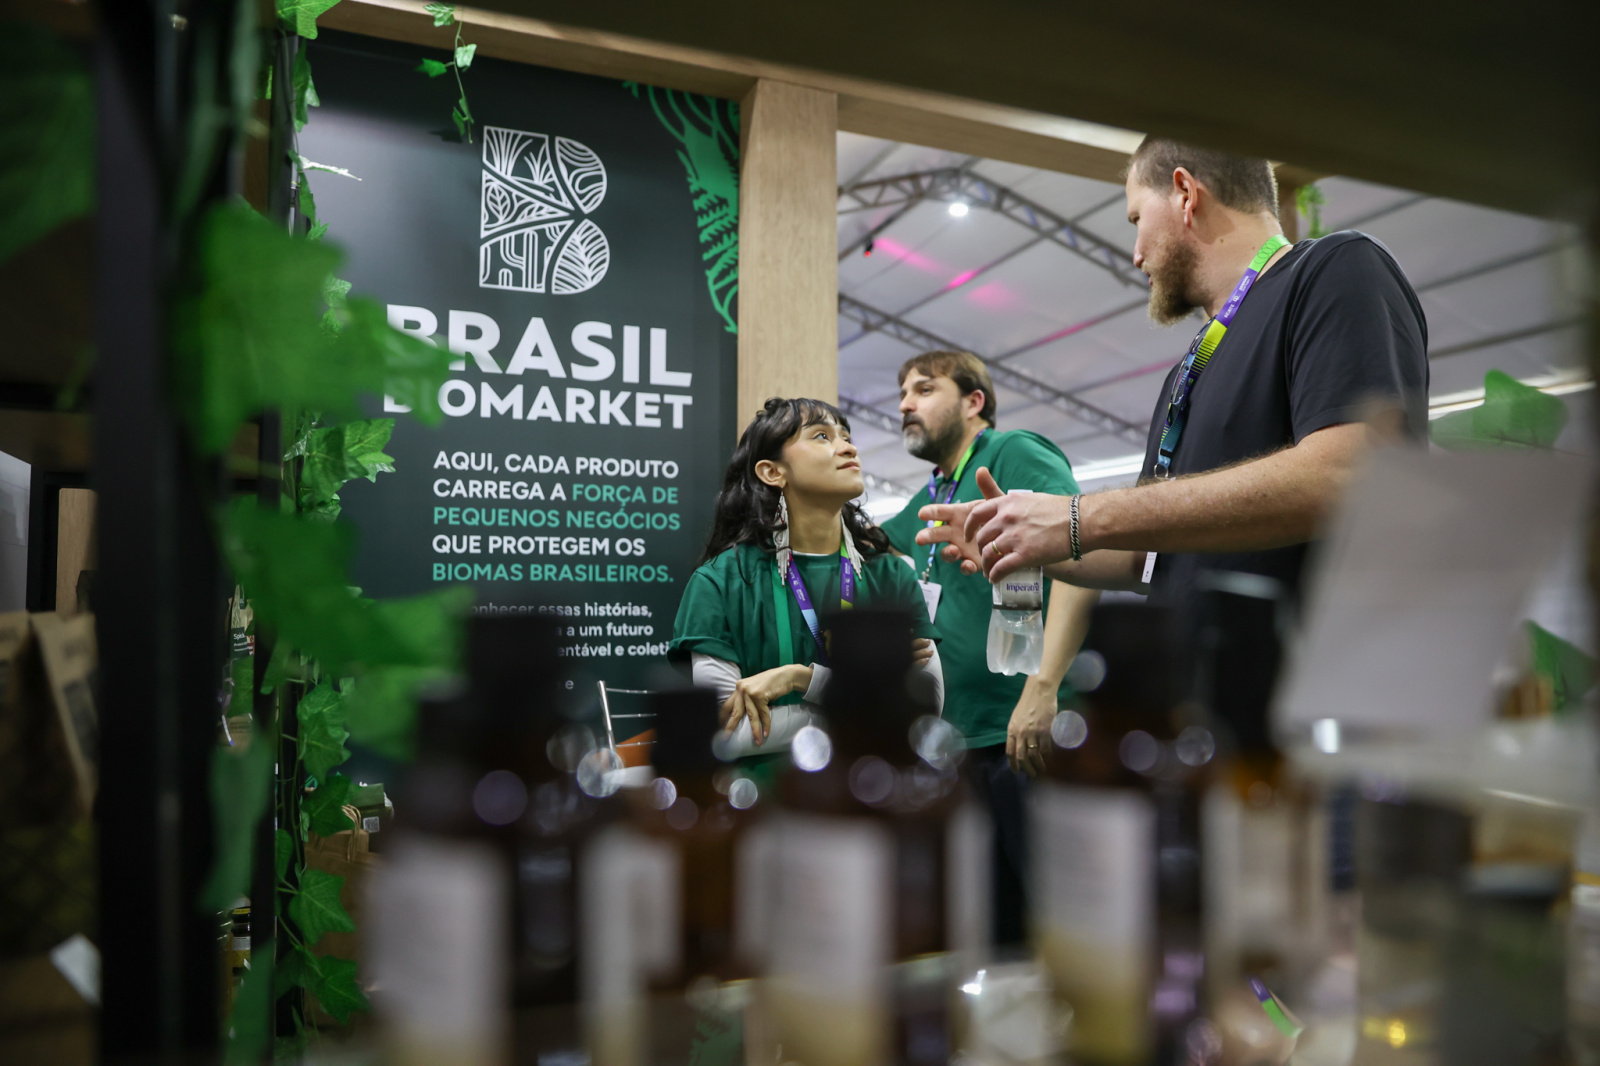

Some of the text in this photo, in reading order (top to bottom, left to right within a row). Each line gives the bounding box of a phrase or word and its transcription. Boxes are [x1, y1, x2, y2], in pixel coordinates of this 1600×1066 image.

[386, 303, 693, 388] BRASIL
[383, 377, 694, 430] OMARKET
[433, 450, 679, 479] AQUI, CADA PRODUTO
[433, 478, 679, 507] CARREGA A FORÇA DE
[433, 506, 681, 531] PEQUENOS NEGÓCIOS
[432, 534, 646, 557] QUE PROTEGEM OS
[432, 562, 674, 583] BIOMAS BRASILEIROS.
[471, 601, 653, 618] onhecer essas histórias,
[579, 625, 603, 637] um
[606, 621, 654, 637] futuro
[556, 640, 671, 657] entável e coleti
